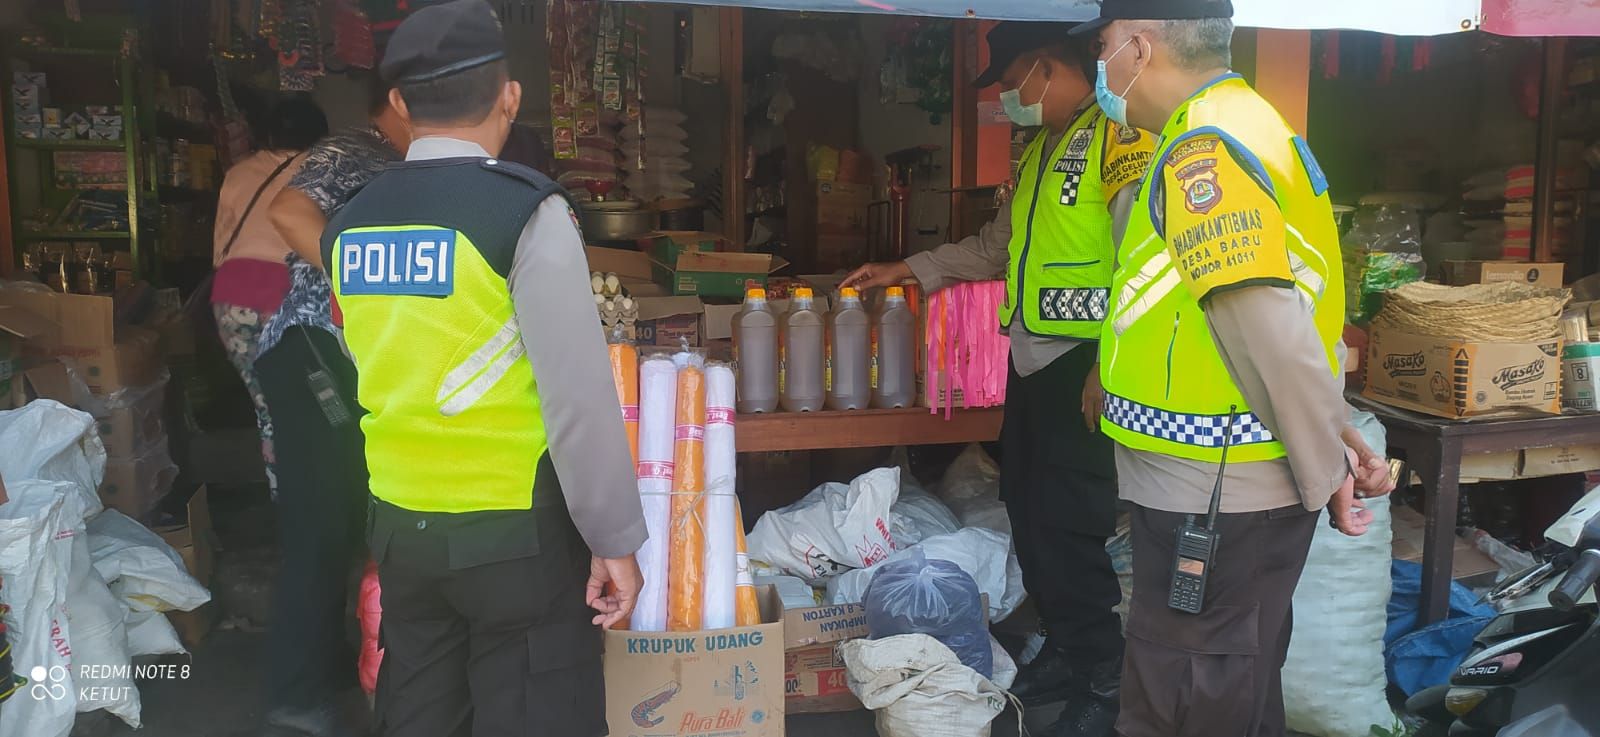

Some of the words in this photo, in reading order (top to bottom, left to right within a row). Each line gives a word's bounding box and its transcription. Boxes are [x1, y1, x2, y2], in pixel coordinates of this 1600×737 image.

[1054, 160, 1085, 173] POLISI
[1172, 208, 1263, 258] BHABINKAMTIBMAS
[343, 241, 448, 283] POLISI
[1182, 247, 1212, 271] DESA
[1219, 235, 1261, 254] BARU
[1190, 260, 1222, 281] NOMOR
[1226, 251, 1256, 267] 41011
[803, 606, 846, 622] KARTON
[627, 638, 696, 654] KRUPUK
[705, 631, 764, 651] UDANG
[1460, 666, 1499, 676] VARIO
[680, 712, 715, 733] Pura
[716, 708, 746, 729] Bali
